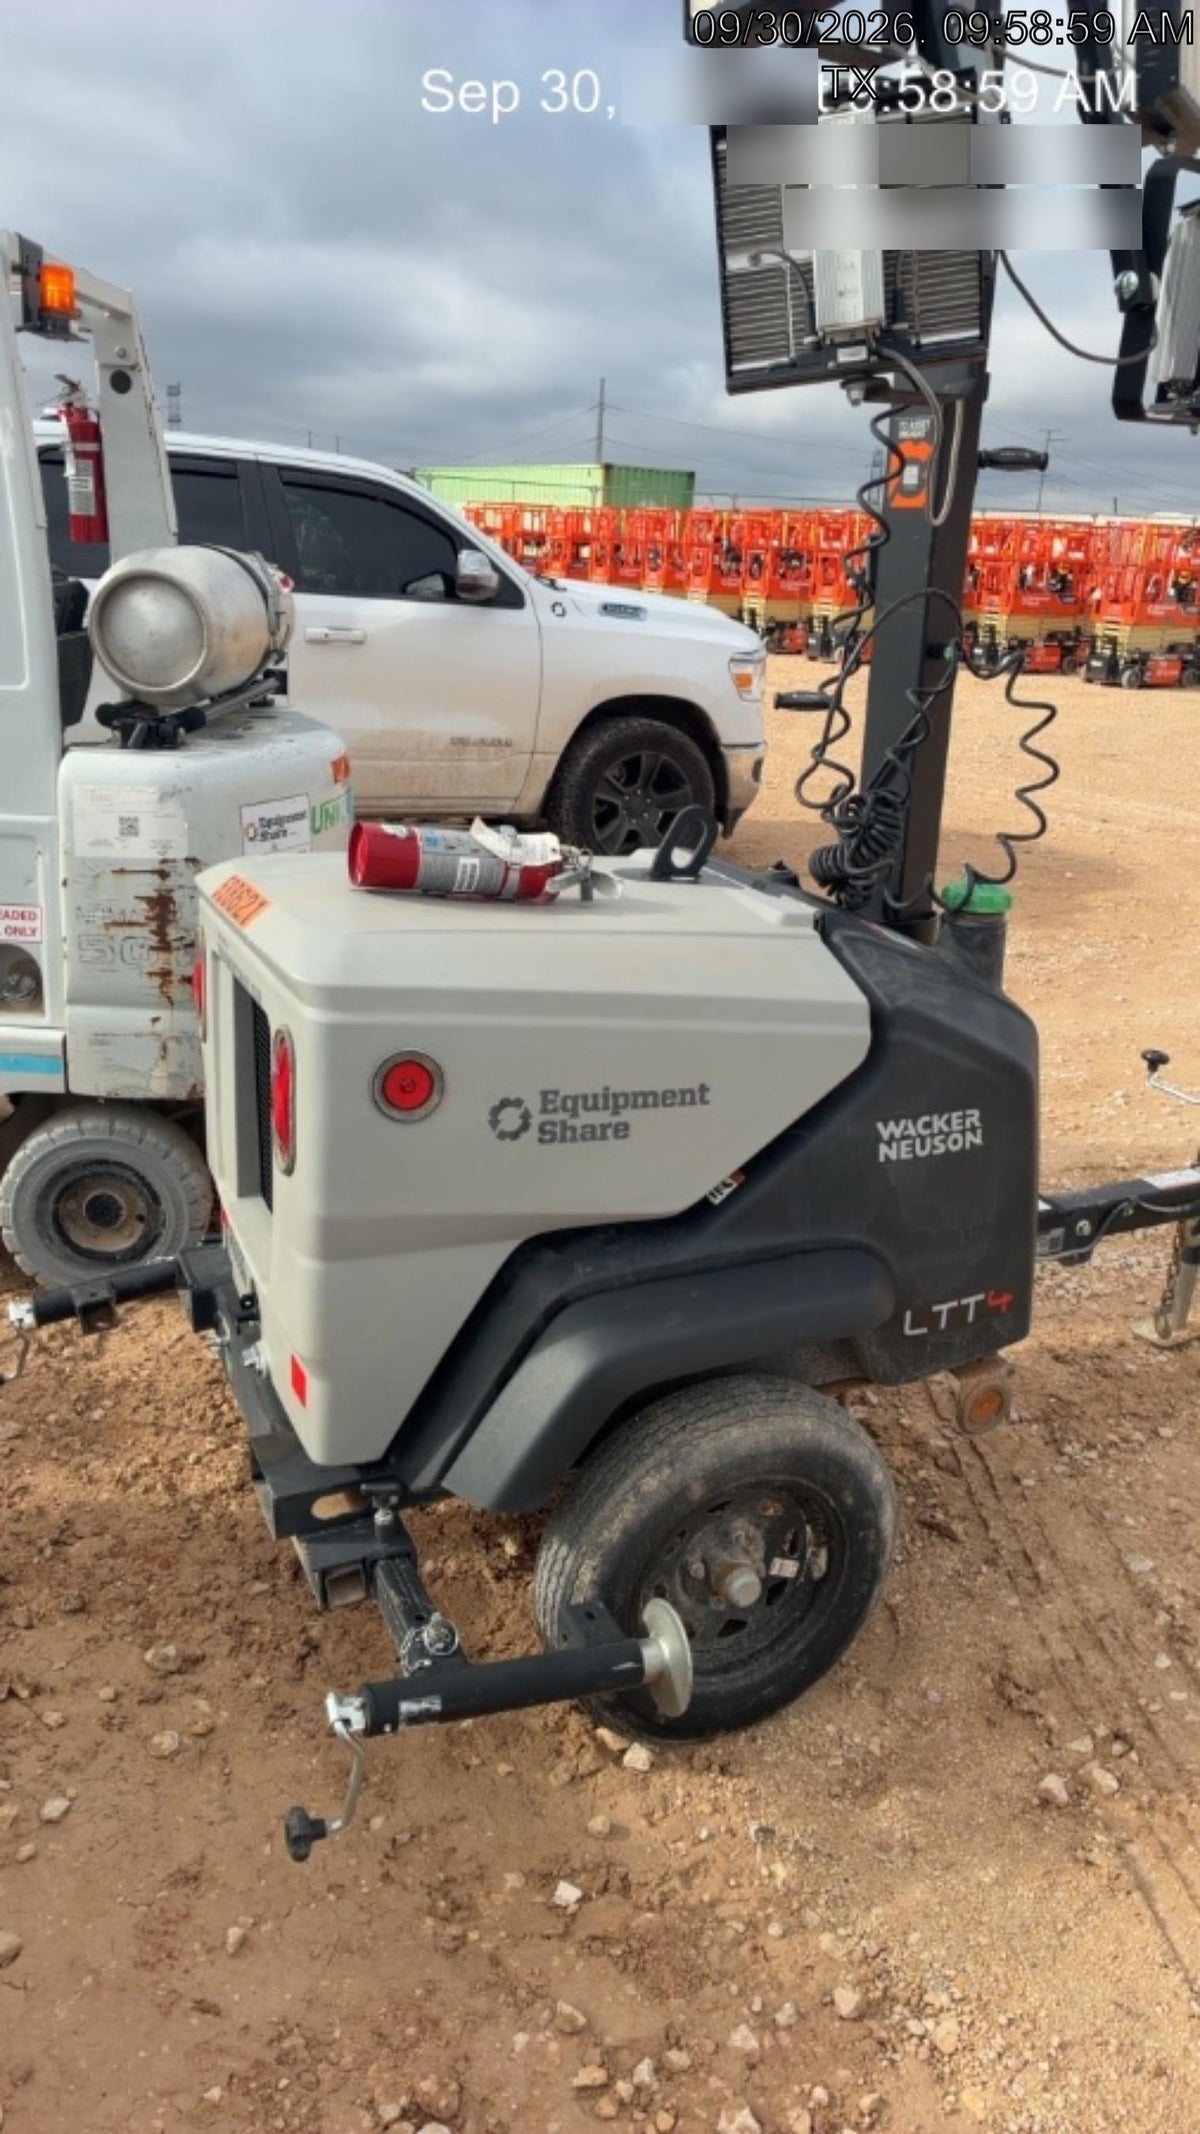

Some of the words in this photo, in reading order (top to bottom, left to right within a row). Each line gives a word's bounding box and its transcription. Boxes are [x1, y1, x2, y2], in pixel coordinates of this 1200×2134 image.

[538, 1082, 711, 1119] Equipment
[537, 1120, 630, 1144] Share
[876, 1109, 983, 1141] WACKER
[878, 1128, 984, 1163] NEUSON
